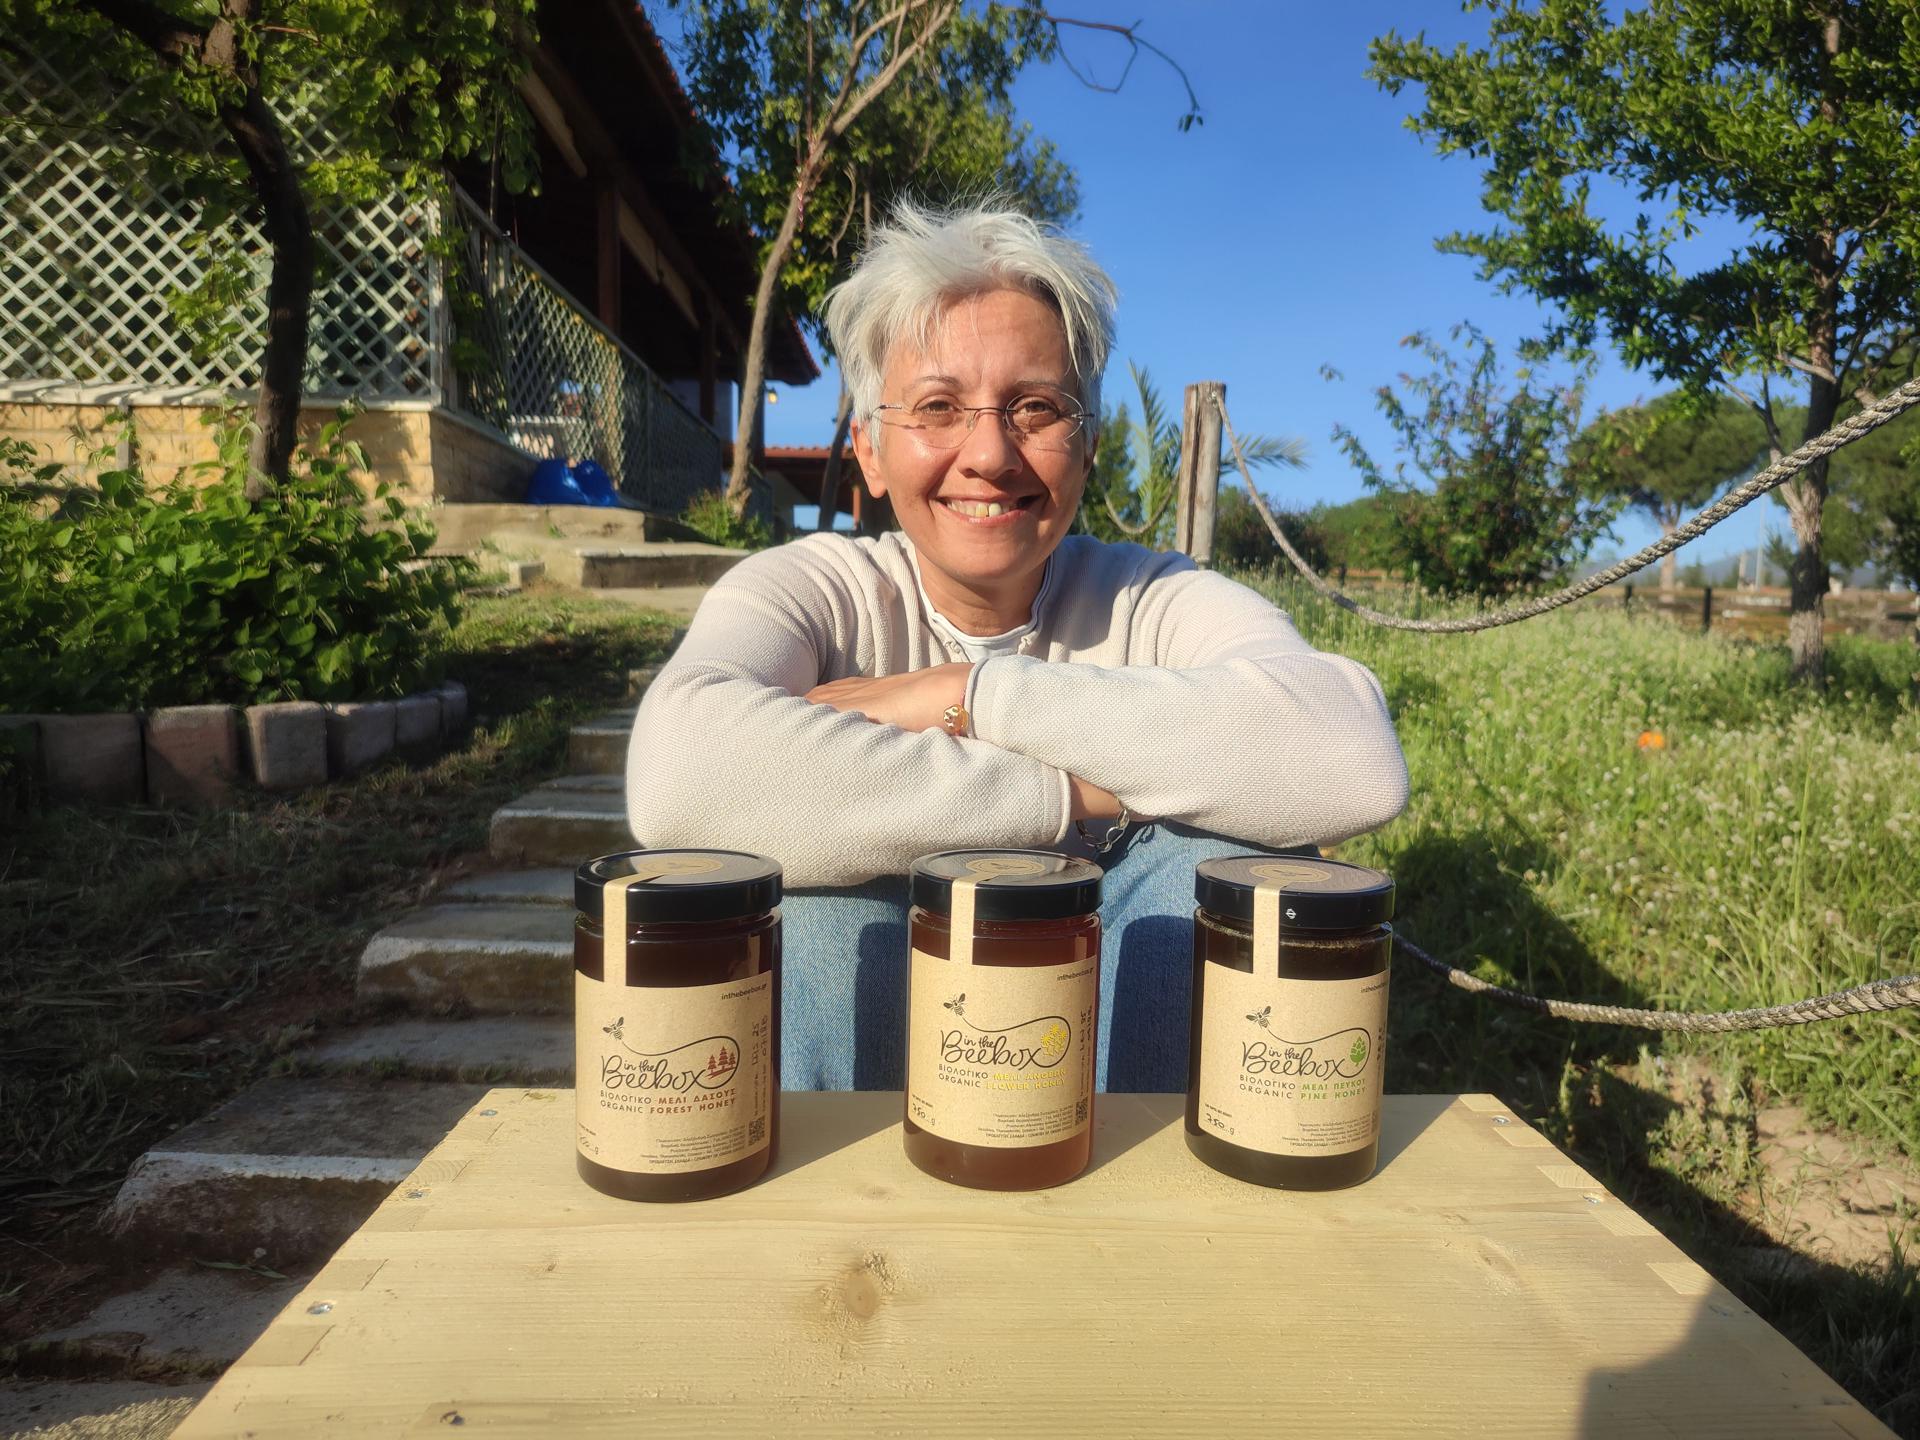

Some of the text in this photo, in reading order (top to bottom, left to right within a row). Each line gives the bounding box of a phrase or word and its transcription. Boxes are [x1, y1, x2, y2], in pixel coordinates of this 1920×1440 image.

[940, 1029, 1042, 1070] Beebox
[964, 1035, 994, 1048] in the
[1242, 1041, 1346, 1081] Beebox
[1269, 1047, 1300, 1060] in the
[601, 1055, 706, 1094] Beebox
[624, 1059, 655, 1073] in the
[938, 1063, 988, 1079] ΒΙΟΛΟΓΙΚΟ
[938, 1073, 1065, 1091] ORGANIC FLOWER HONEY
[1239, 1074, 1296, 1090] ΒΙΟΛΟΓΙΚΟ
[1302, 1083, 1328, 1091] ΜΕΛΙ
[600, 1090, 652, 1105] ΒΙΟΛΟΓΙΚΟ
[693, 1088, 736, 1103] ΔΑΣΟΥΣ
[1239, 1083, 1366, 1100] ORGANIC PINE HONEY
[600, 1098, 735, 1114] ORGANIC FOREST HONEY
